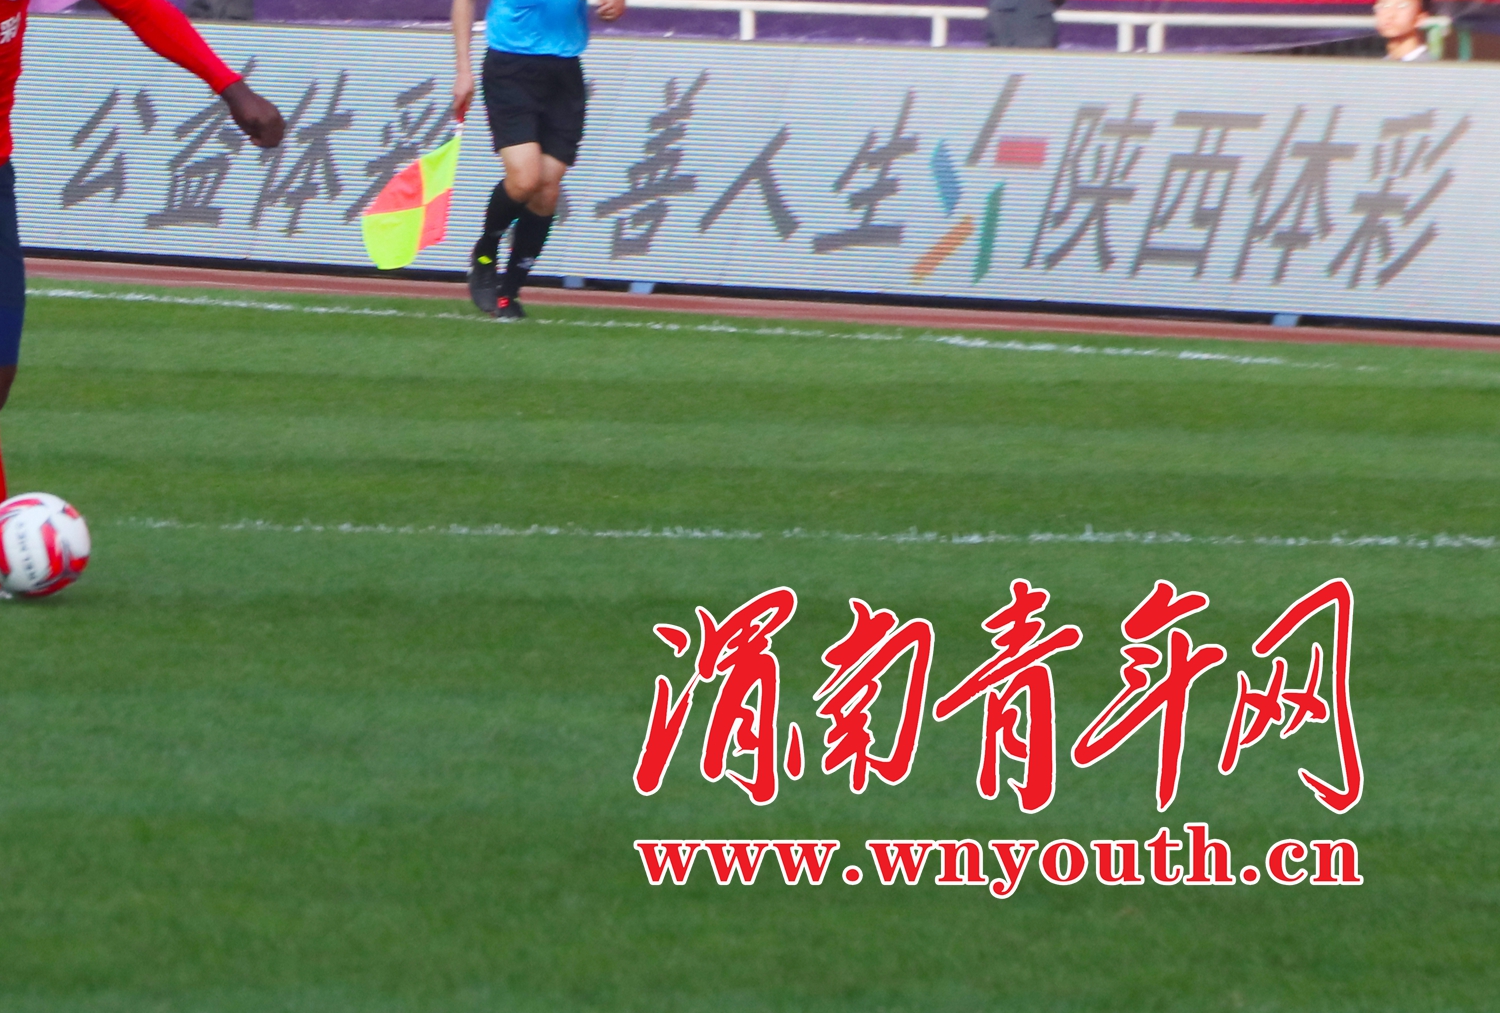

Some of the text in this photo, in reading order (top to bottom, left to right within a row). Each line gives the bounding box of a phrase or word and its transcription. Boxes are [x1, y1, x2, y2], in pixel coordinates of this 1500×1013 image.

[556, 68, 922, 260] 善人生
[1023, 94, 1471, 290] 陕西体彩
